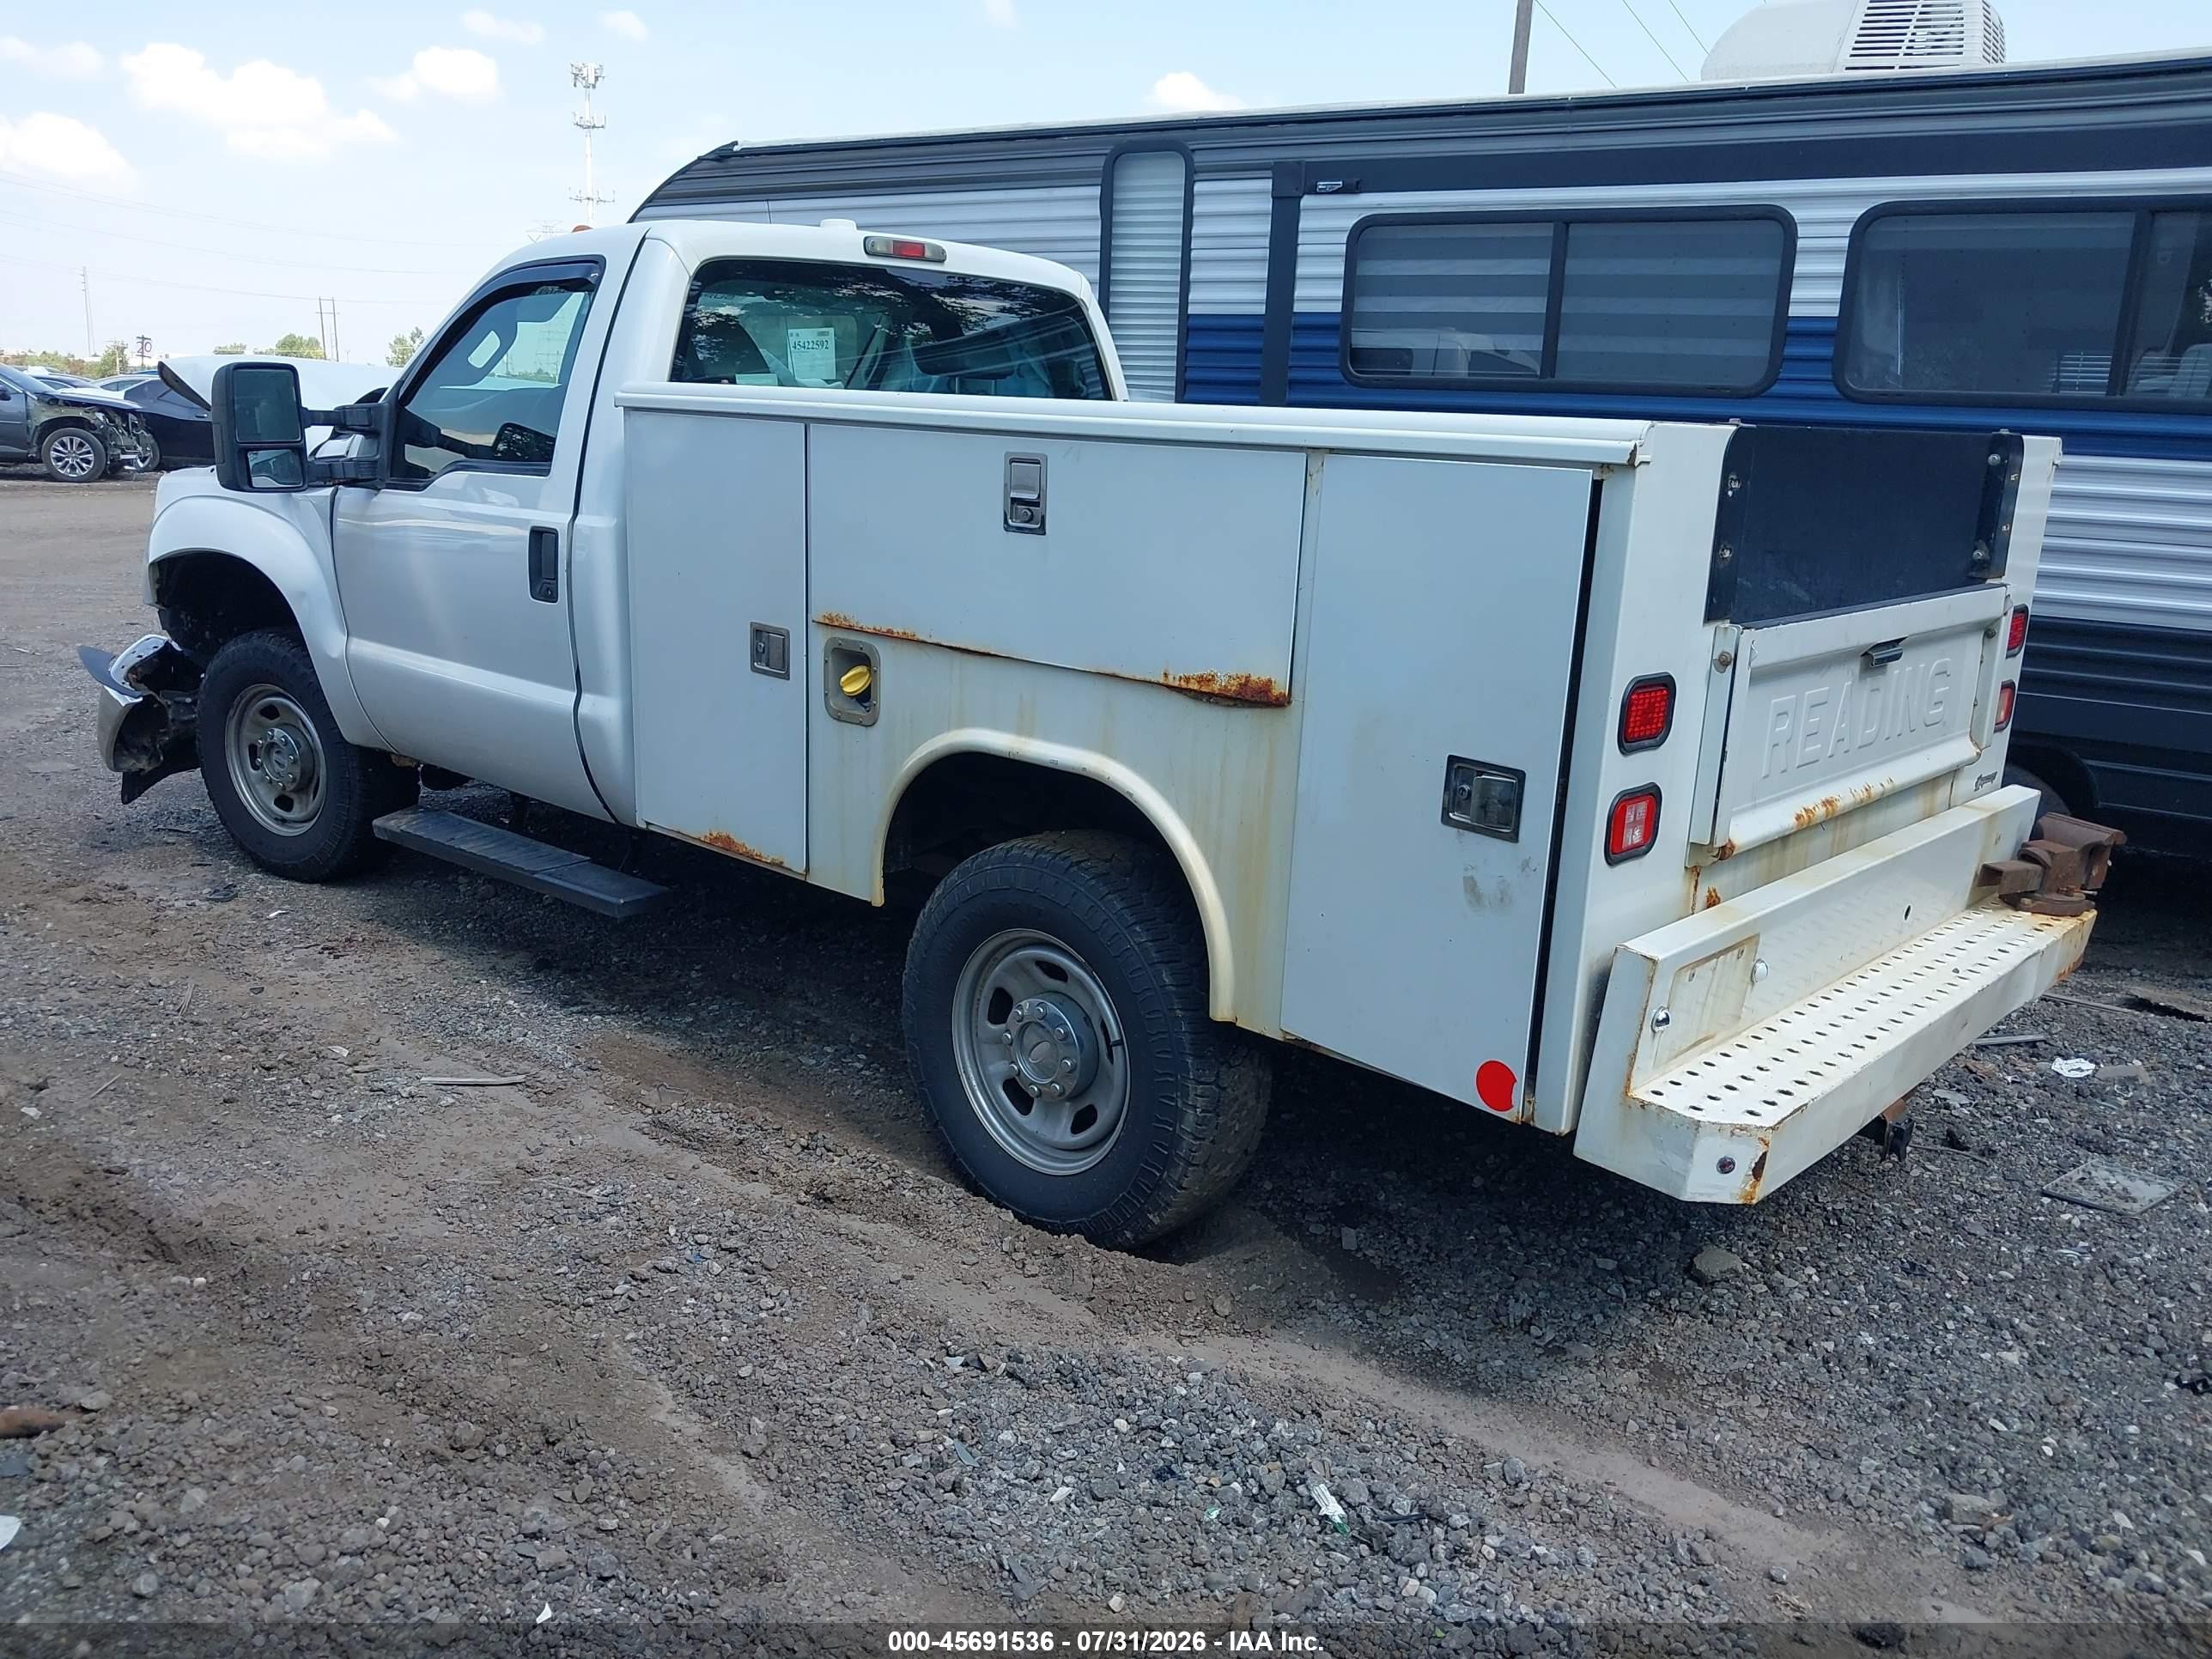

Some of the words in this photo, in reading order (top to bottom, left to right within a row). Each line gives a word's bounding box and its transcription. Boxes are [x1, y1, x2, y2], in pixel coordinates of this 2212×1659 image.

[137, 342, 152, 353] 20
[792, 340, 830, 350] 45422592
[1762, 658, 1951, 779] READING
